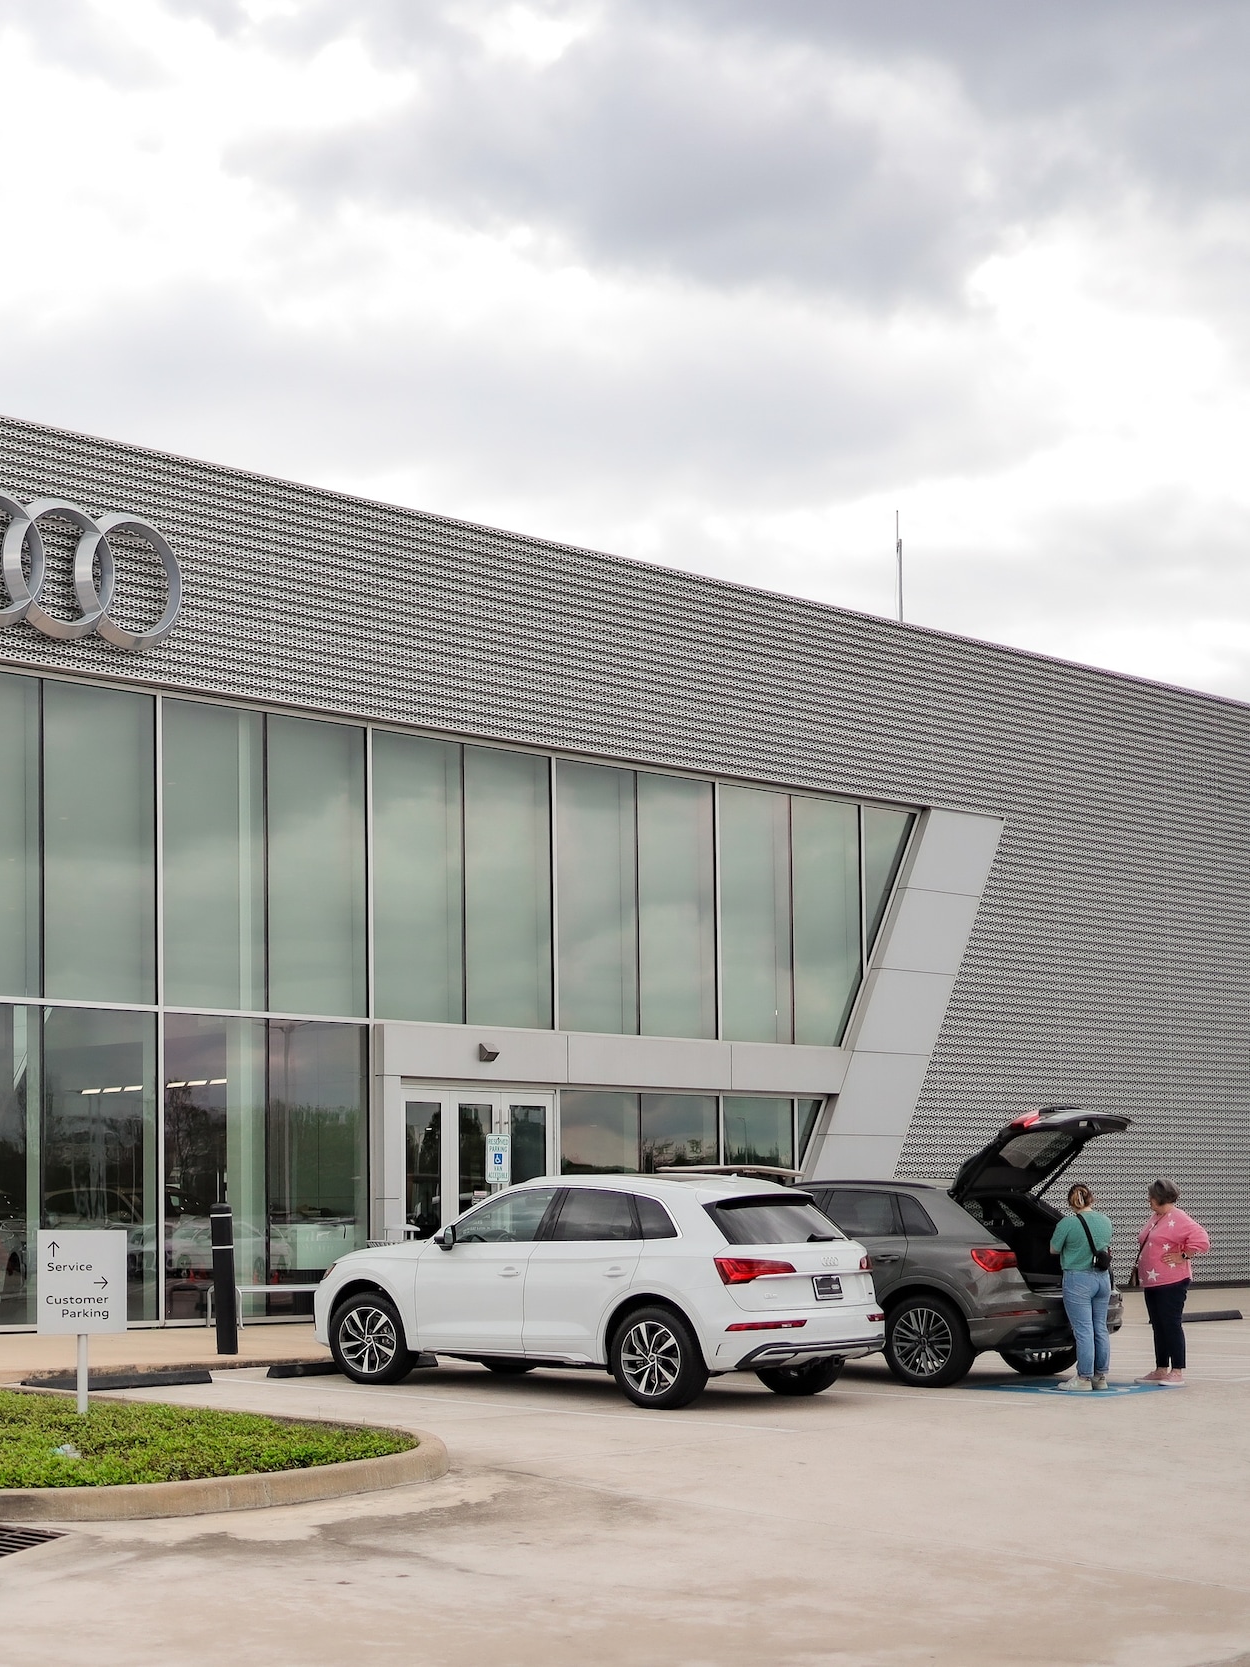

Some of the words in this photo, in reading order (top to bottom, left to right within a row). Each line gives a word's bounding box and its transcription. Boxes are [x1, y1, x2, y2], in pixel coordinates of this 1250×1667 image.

[46, 1262, 93, 1272] Service
[45, 1295, 109, 1305] Customer
[61, 1308, 110, 1320] Parking
